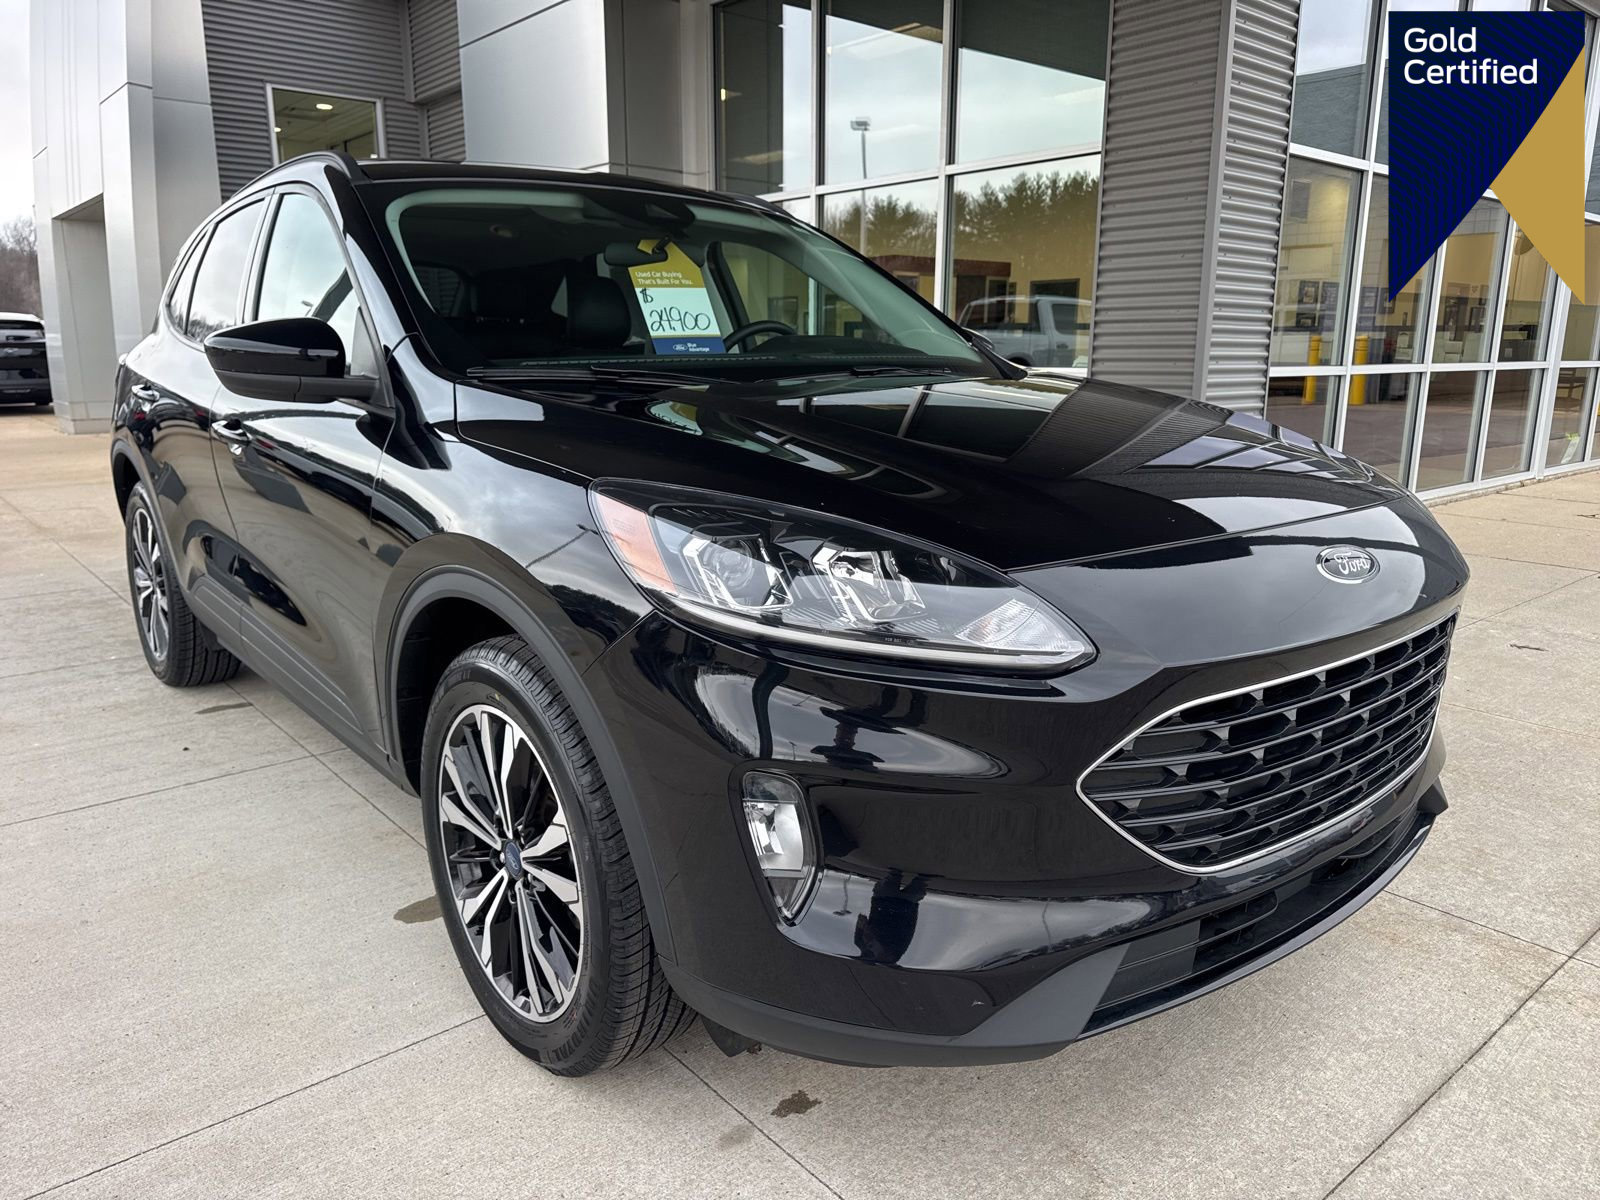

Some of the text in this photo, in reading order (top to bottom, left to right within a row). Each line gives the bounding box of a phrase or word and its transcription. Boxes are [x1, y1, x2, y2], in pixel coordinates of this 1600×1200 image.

[662, 271, 682, 279] Buying
[640, 287, 654, 304] $
[1333, 551, 1371, 575] Ford
